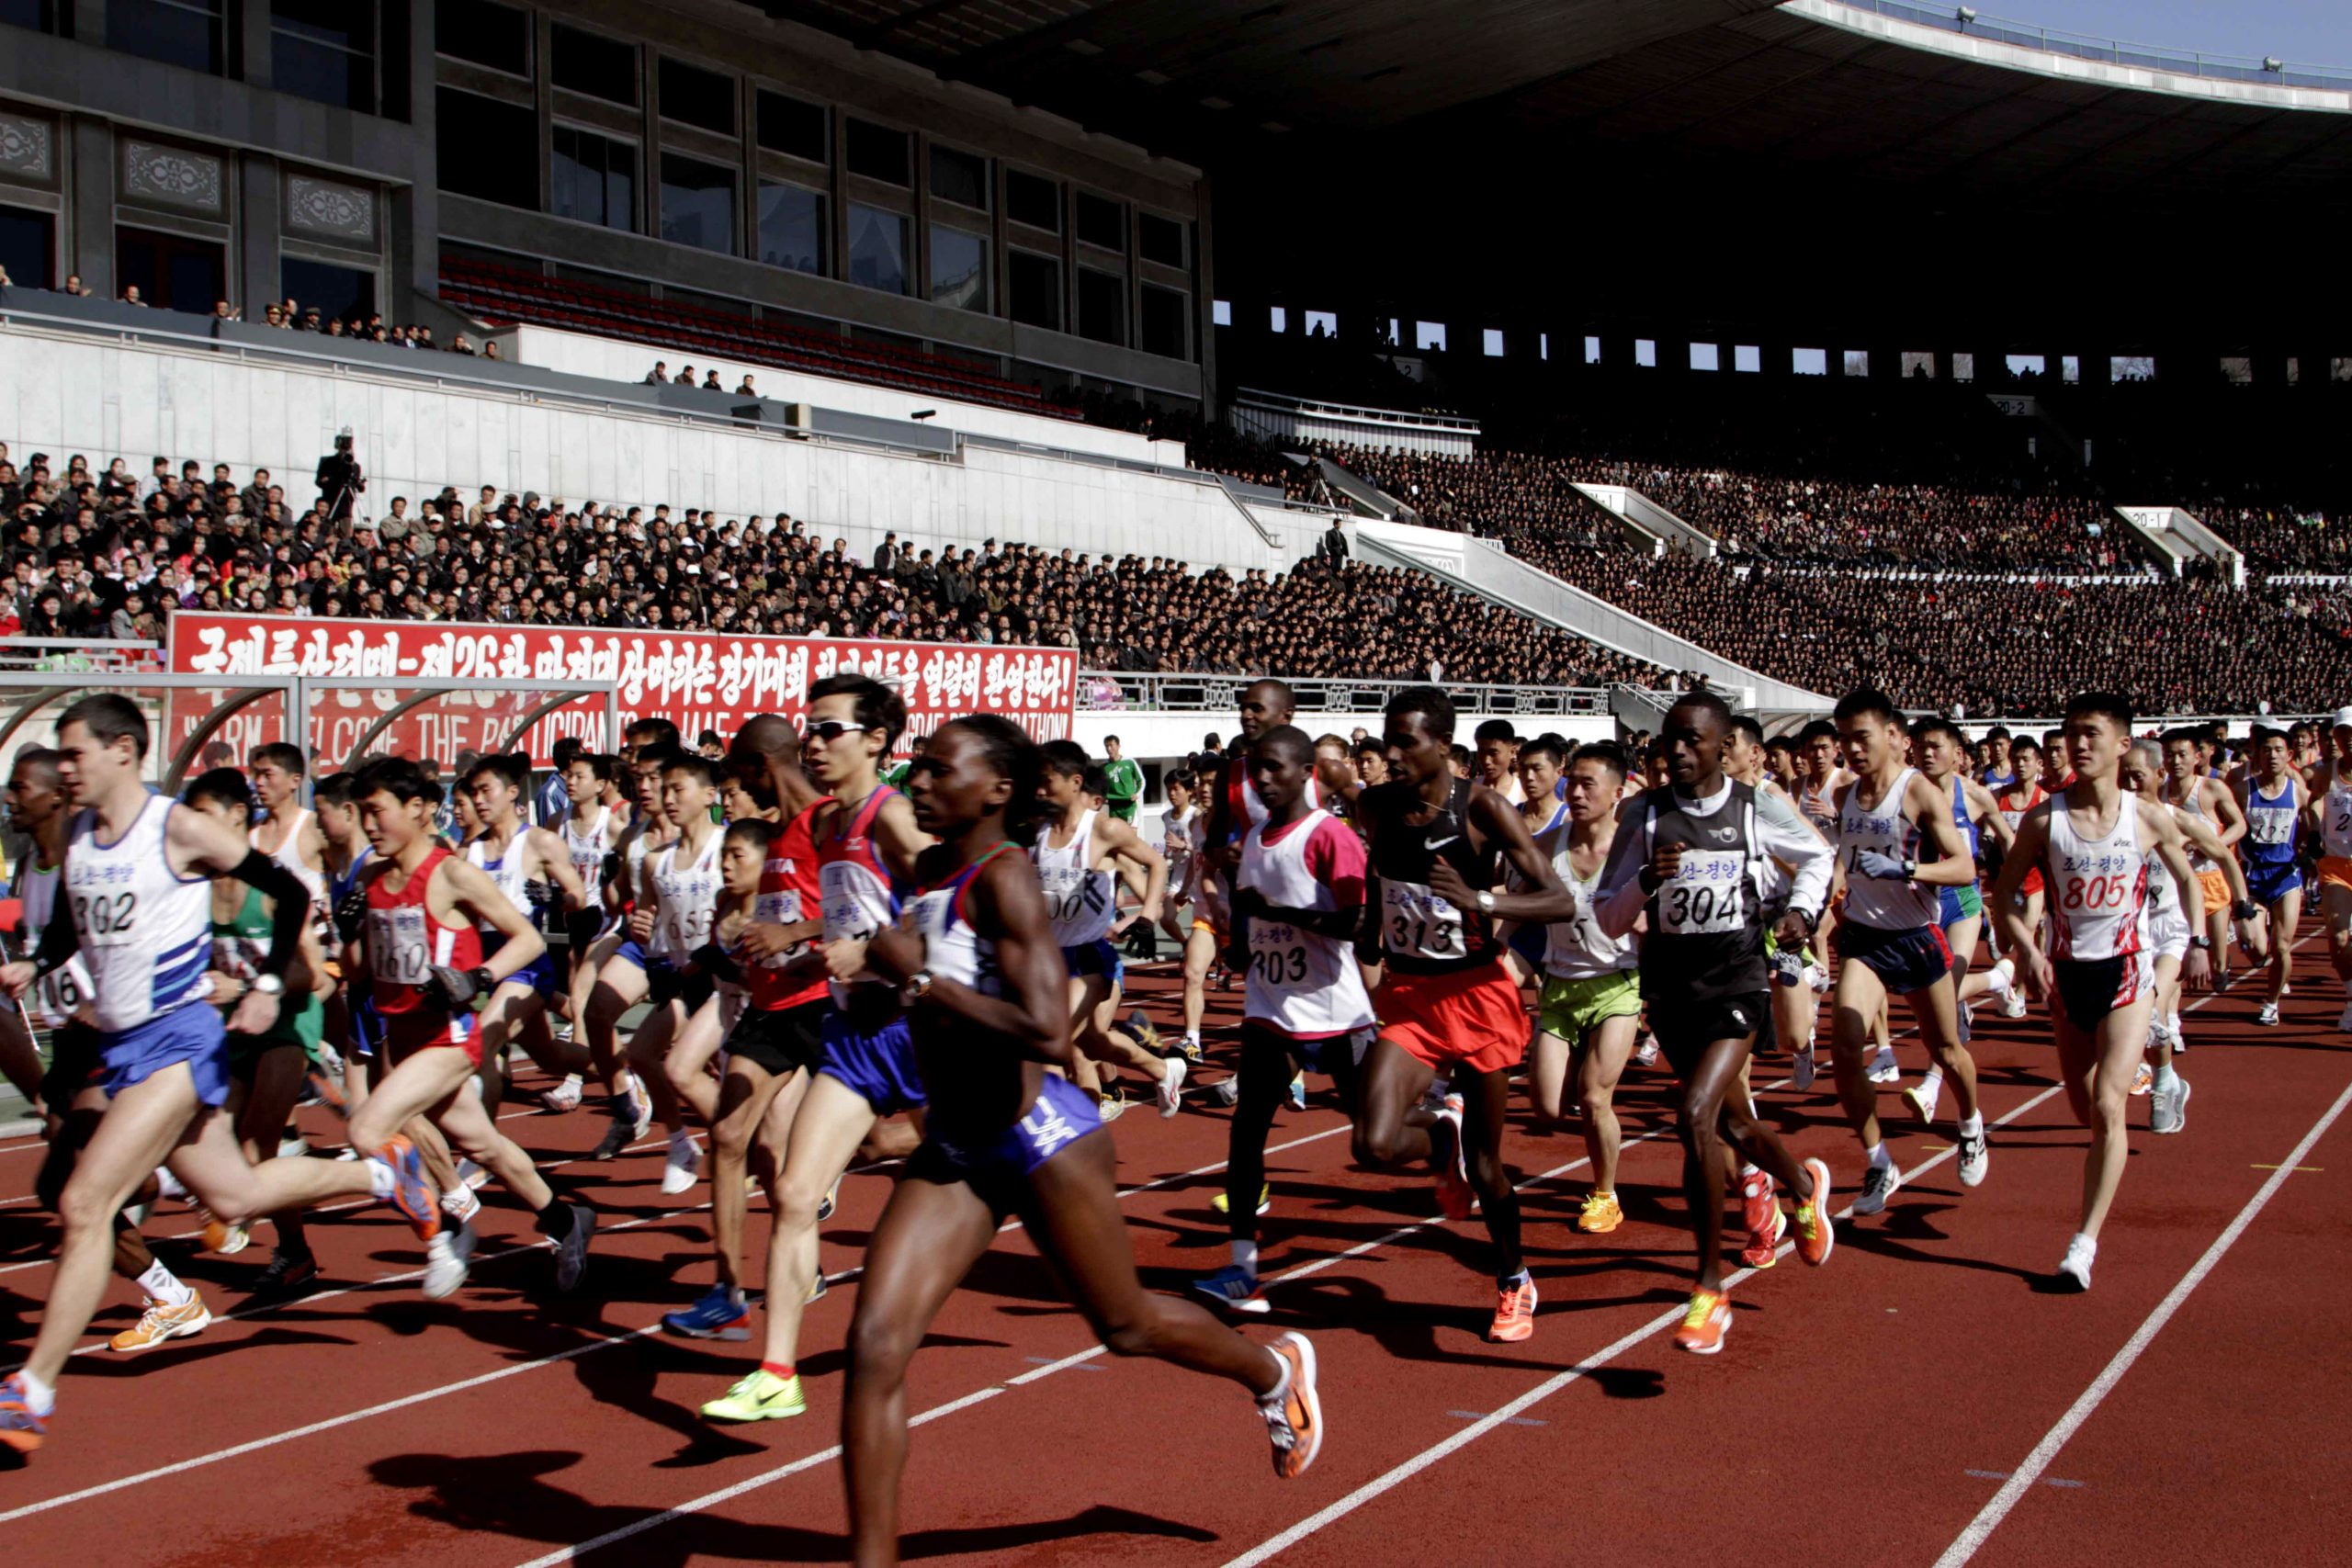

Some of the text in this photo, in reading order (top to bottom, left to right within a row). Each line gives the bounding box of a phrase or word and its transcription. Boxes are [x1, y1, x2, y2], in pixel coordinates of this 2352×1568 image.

[922, 650, 981, 708] 열렬히
[984, 653, 1071, 709] 환영한다!
[415, 714, 469, 764] THE
[2063, 854, 2126, 873] 조선-평양
[1387, 889, 1450, 913] 조선-평양
[1668, 886, 1737, 927] 304
[2063, 874, 2127, 909] 805
[74, 891, 136, 935] 302
[1392, 916, 1453, 953] 313
